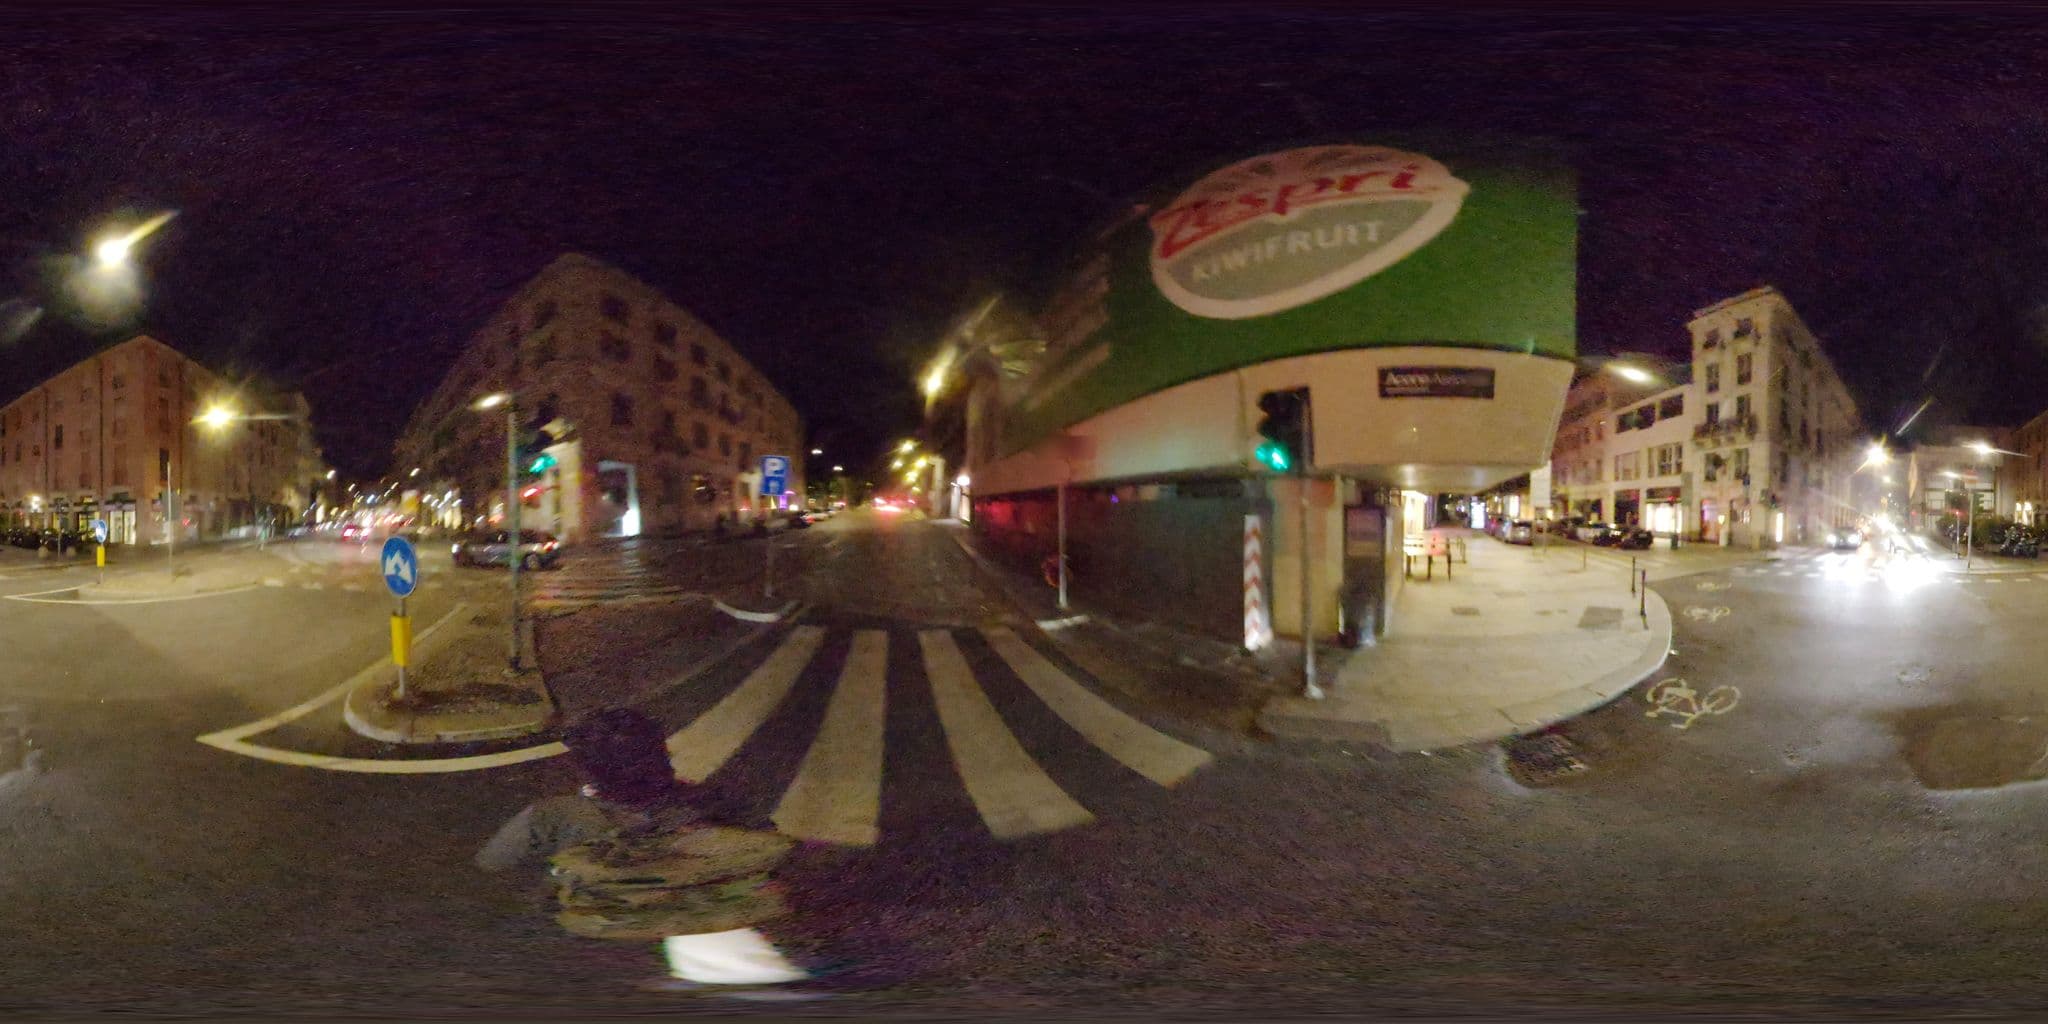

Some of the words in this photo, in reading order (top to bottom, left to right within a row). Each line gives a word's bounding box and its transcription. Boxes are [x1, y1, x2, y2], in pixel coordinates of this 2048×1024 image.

[1150, 163, 1420, 260] Zespri
[1194, 223, 1383, 281] KIWIFRUIT
[765, 458, 785, 477] P
